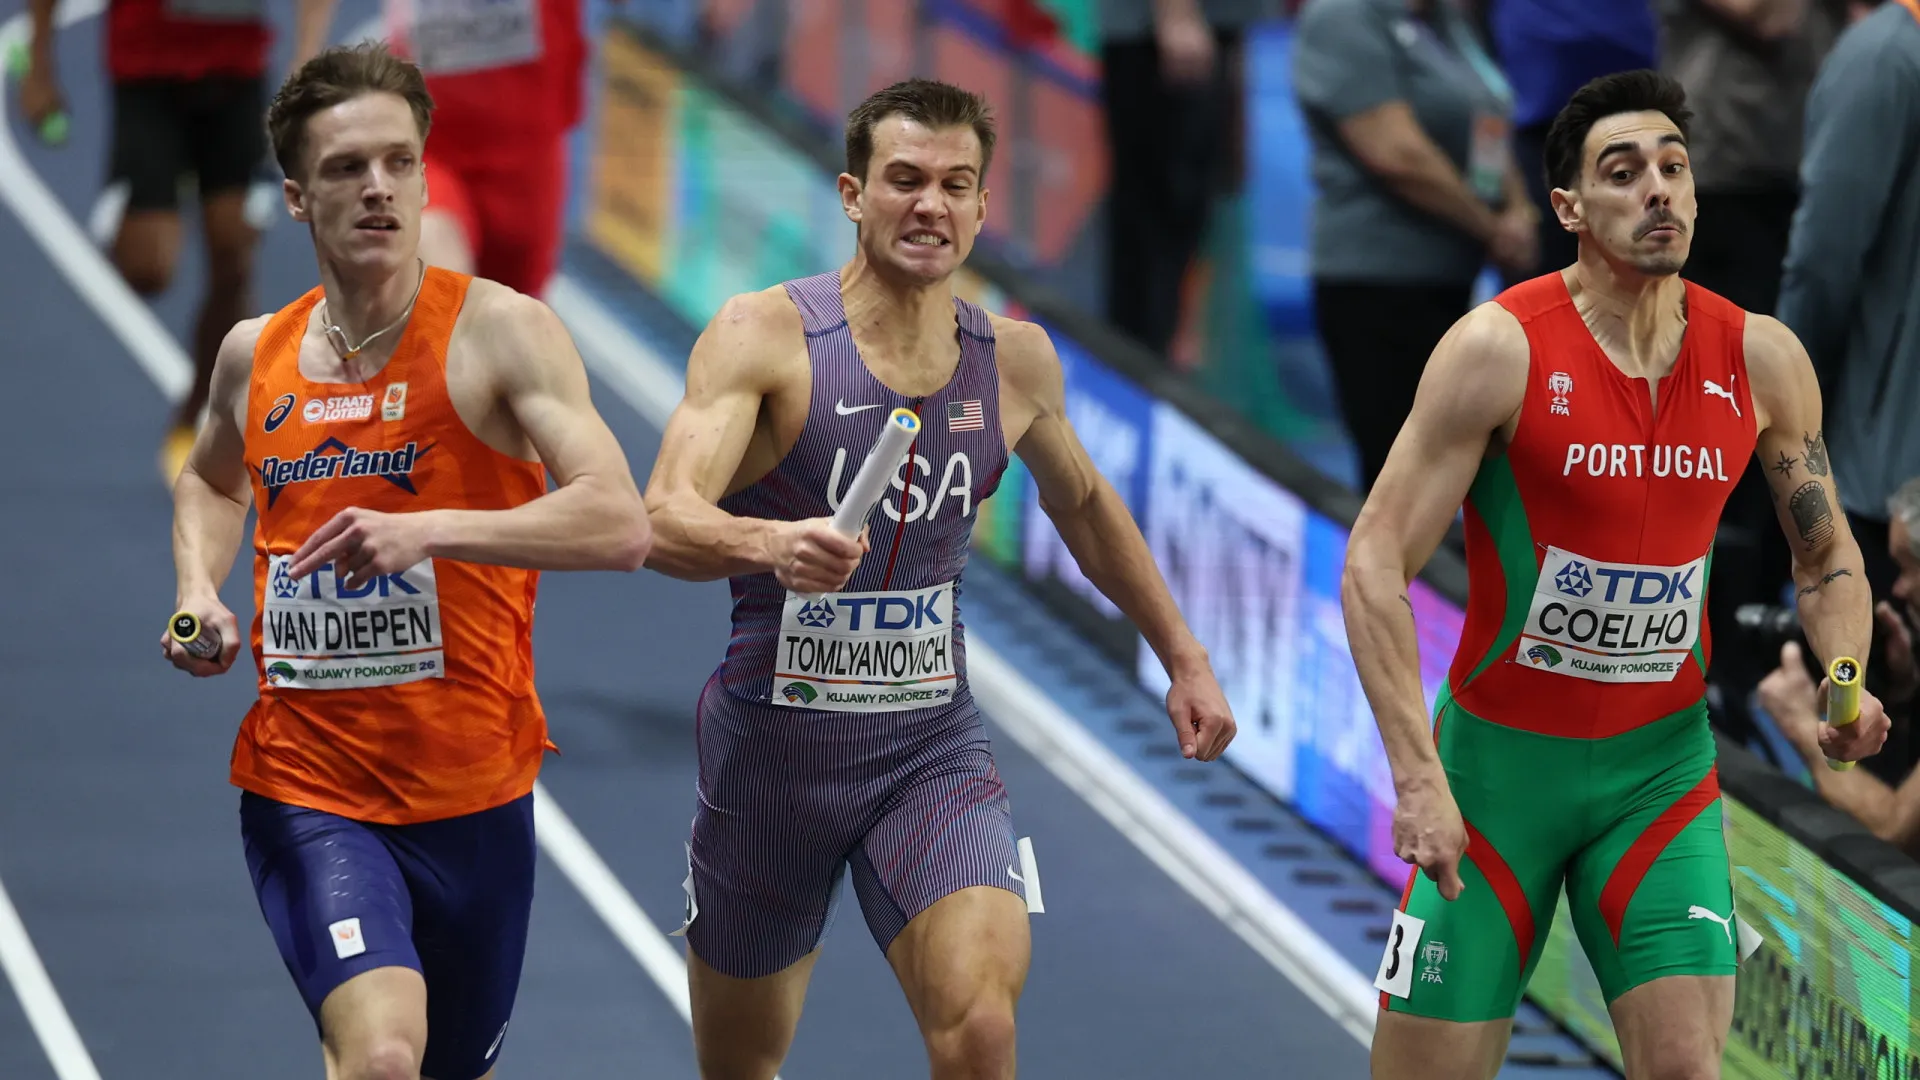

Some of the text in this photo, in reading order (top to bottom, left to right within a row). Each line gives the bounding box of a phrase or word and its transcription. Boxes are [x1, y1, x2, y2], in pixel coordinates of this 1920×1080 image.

[326, 394, 374, 409] STAATS
[1550, 404, 1570, 417] FPA
[1563, 443, 1729, 482] PORTUGAL
[1595, 565, 1697, 604] TDK
[269, 605, 433, 650] VAN DIEPEN
[836, 590, 943, 631] TDK
[1538, 602, 1688, 649] COELHO
[303, 660, 436, 680] KUJAWY POMORZE 26
[786, 634, 948, 678] TOMLYANOVICH
[1570, 658, 1619, 674] KUJAWY
[1620, 661, 1674, 674] POMORZE
[826, 691, 876, 704] KUJAWY
[878, 690, 933, 704] POMORZE
[1385, 923, 1404, 980] 3
[1420, 972, 1443, 984] FPA
